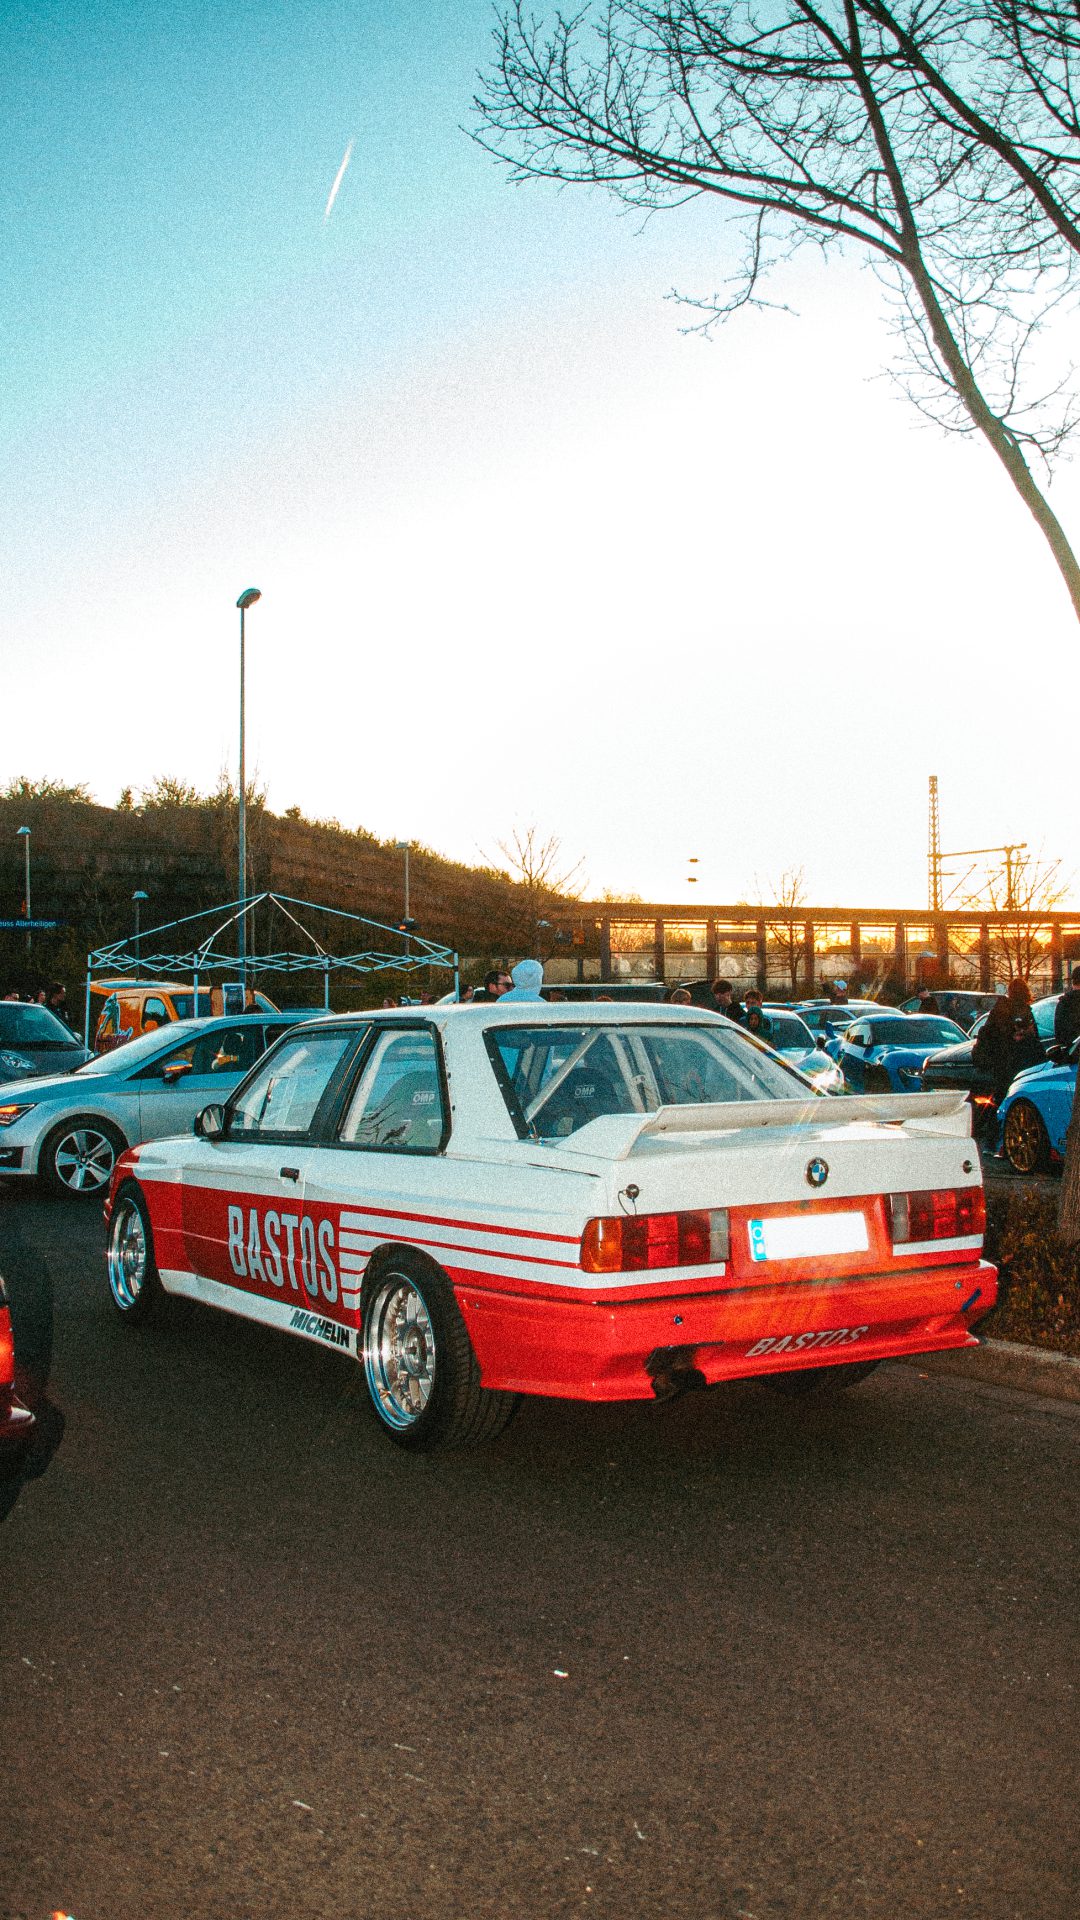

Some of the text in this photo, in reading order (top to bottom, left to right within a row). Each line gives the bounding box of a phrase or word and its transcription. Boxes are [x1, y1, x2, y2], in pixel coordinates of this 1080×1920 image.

[412, 1093, 435, 1103] OMP
[574, 1087, 595, 1097] OMP
[228, 1205, 338, 1303] BASTOS
[290, 1310, 350, 1348] MICHELIN
[745, 1326, 869, 1357] BASTOS
